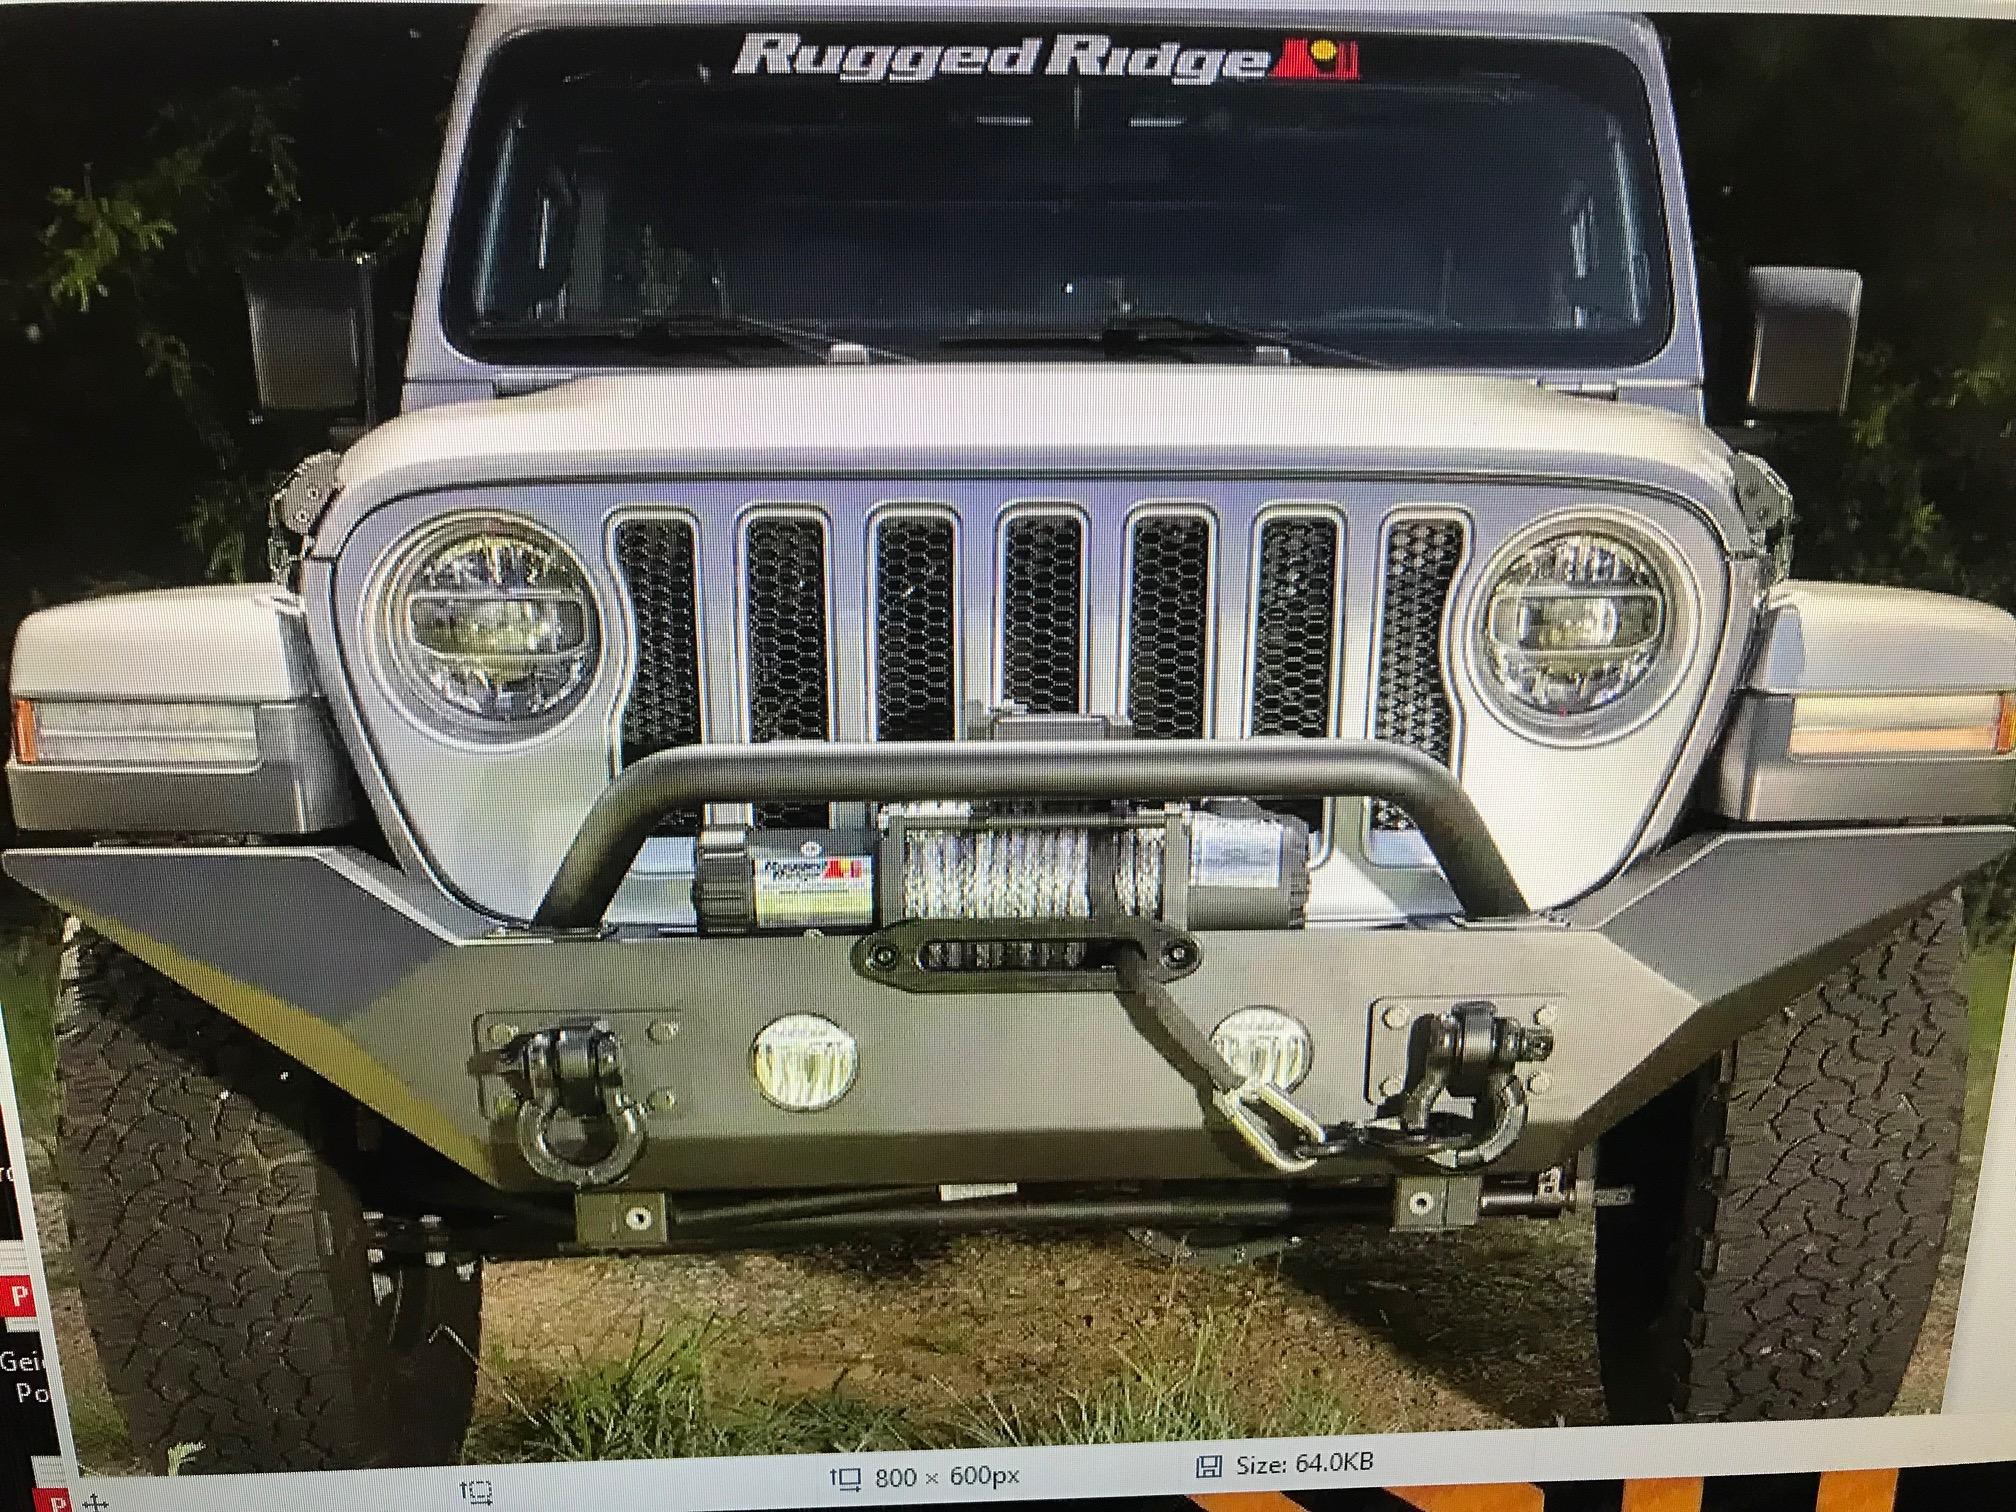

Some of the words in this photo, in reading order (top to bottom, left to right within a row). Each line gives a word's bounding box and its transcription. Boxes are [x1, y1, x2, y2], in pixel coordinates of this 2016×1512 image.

[733, 32, 1043, 83] Rugged
[1044, 34, 1272, 86] Ridge
[11, 1285, 29, 1307] P
[1236, 1455, 1287, 1475] Size:
[1296, 1451, 1374, 1473] 64.0KB
[876, 1468, 917, 1488] 800
[950, 1465, 1020, 1490] 600px
